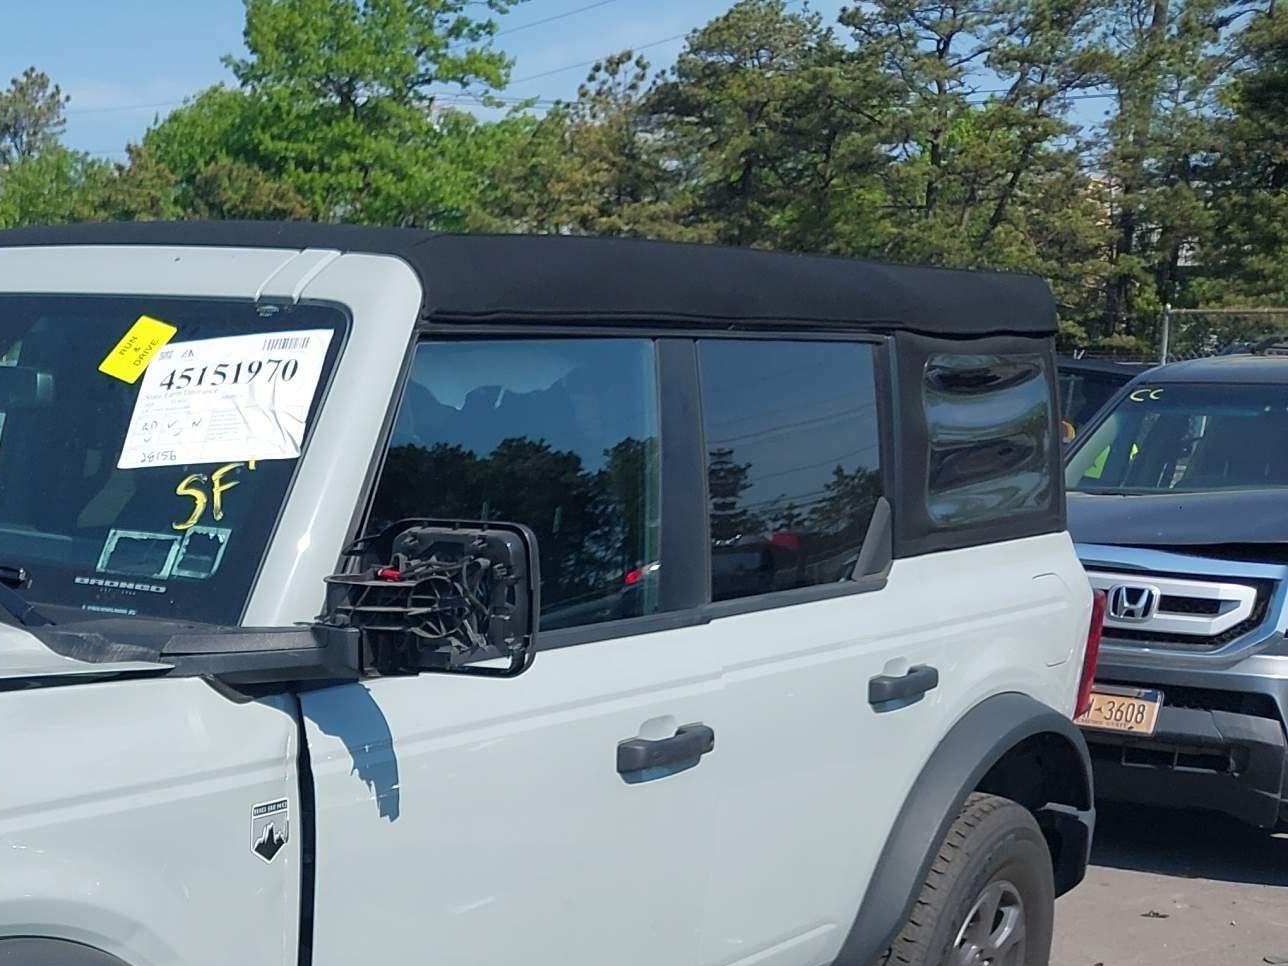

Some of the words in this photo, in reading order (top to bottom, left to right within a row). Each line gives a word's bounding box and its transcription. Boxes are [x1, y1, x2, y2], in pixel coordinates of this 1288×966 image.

[119, 335, 139, 356] RUN
[132, 338, 160, 367] DRIVE
[159, 358, 299, 391] 45151970
[74, 576, 167, 593] BRONCO
[1104, 700, 1146, 725] 3608
